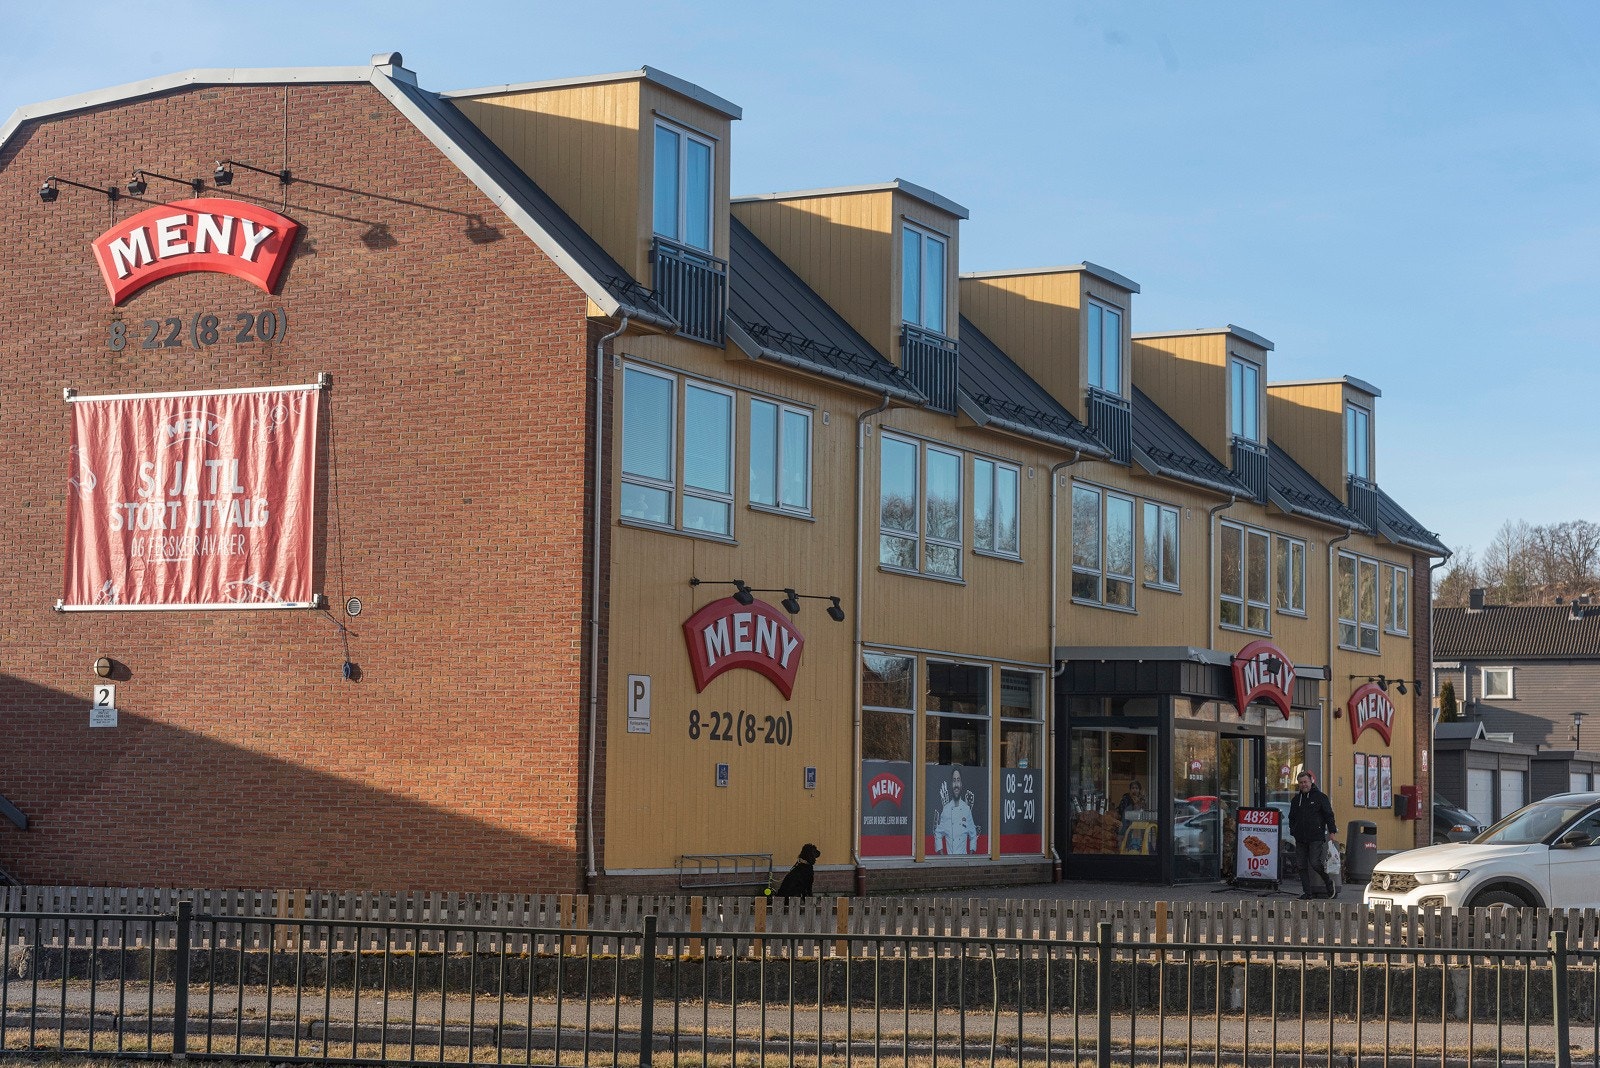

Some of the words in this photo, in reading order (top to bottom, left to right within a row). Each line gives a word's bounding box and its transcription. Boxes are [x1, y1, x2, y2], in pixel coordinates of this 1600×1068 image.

[108, 213, 274, 280] MENY
[166, 418, 219, 438] MENY
[169, 459, 199, 496] JA
[205, 458, 244, 495] TIL
[109, 501, 182, 531] STORT
[187, 498, 269, 529] UTVALG
[131, 536, 145, 557] OG
[148, 534, 192, 557] FERSKE
[193, 529, 245, 556] RÅVARER
[704, 613, 798, 669] MENY
[98, 688, 110, 706] 2
[634, 681, 645, 712] P
[1358, 693, 1394, 728] MENY
[872, 780, 901, 799] MENY
[1244, 810, 1270, 824] 48%
